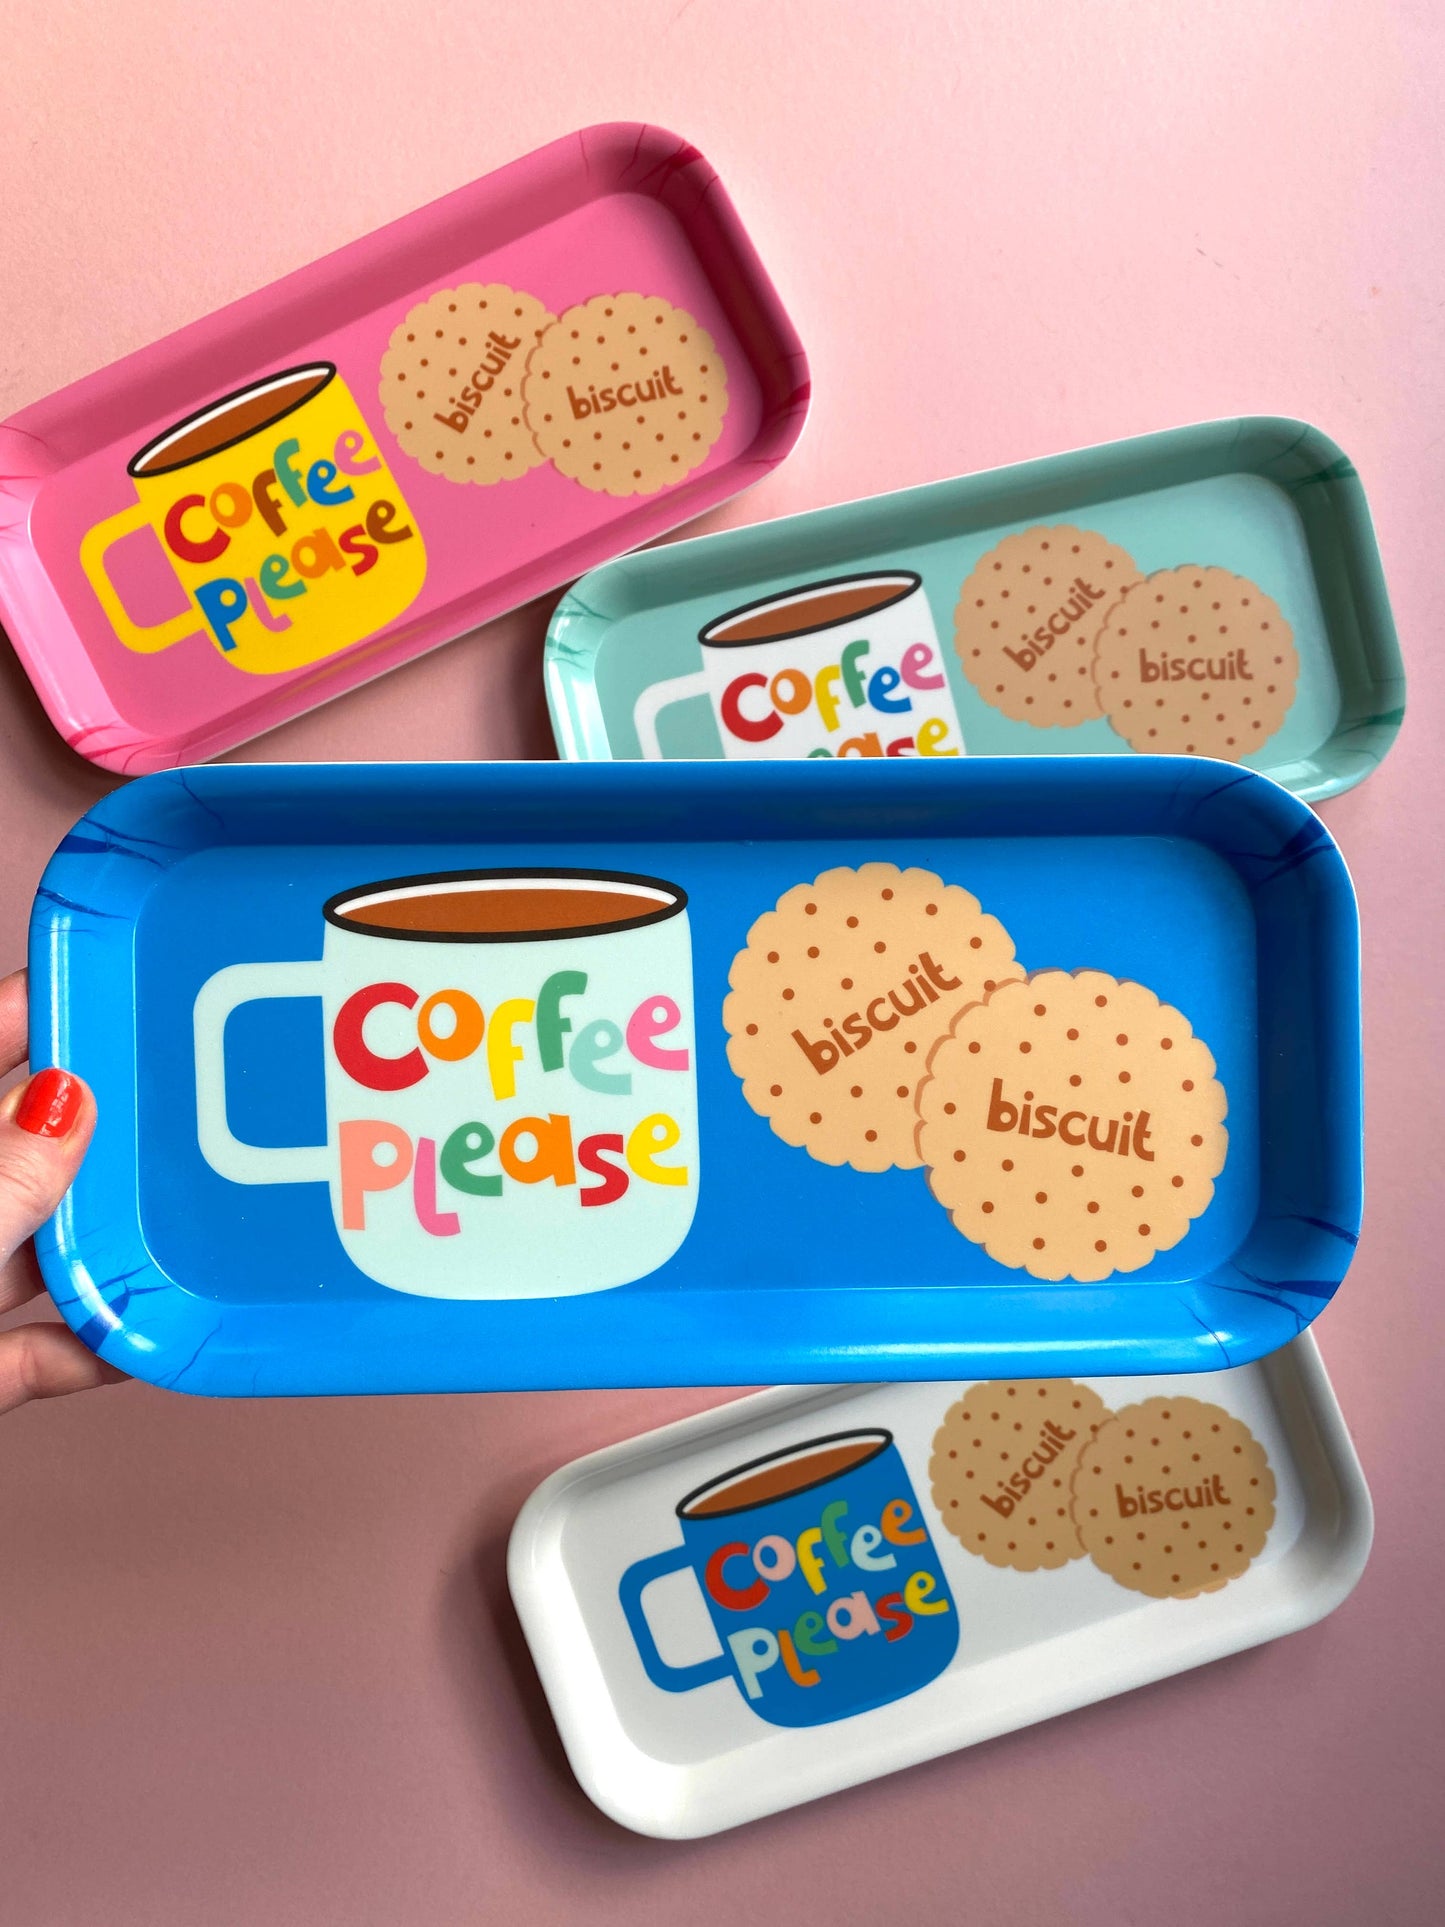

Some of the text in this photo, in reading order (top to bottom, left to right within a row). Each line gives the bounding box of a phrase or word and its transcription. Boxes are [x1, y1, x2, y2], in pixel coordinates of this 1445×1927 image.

[433, 331, 522, 434] biscuit
[565, 365, 684, 420] biscuit
[1002, 575, 1106, 672] biscuit
[1138, 647, 1254, 683] biscuit
[791, 952, 963, 1076] biscuit
[986, 1077, 1155, 1162] biscuit
[980, 1419, 1077, 1519] biscuit
[1115, 1474, 1231, 1519] biscuit
